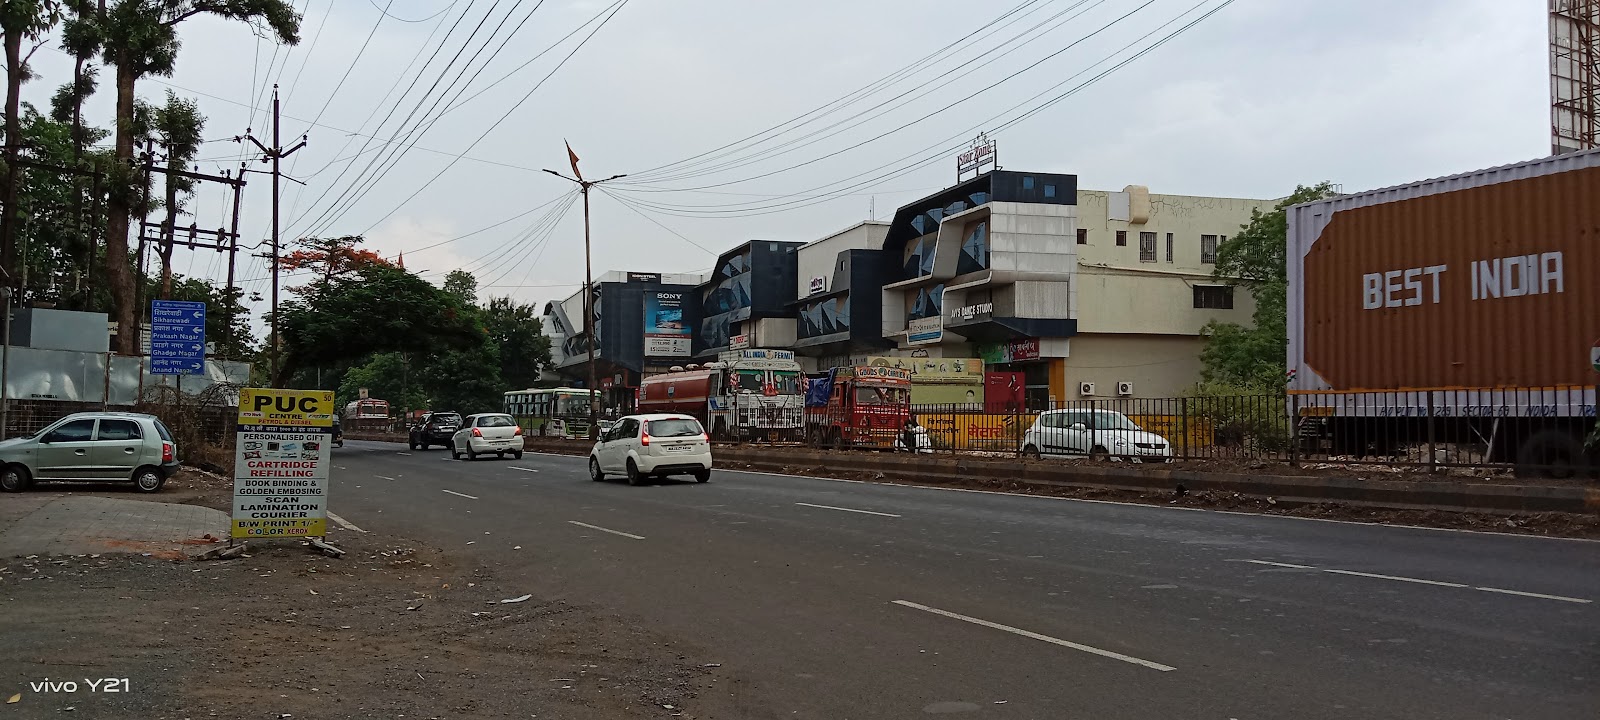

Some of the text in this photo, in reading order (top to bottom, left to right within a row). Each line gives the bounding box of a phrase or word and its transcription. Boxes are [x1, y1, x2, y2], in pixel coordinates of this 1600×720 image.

[1363, 251, 1564, 310] BEST INDIA
[962, 305, 976, 317] DANCE
[976, 302, 993, 314] STUDIO
[743, 350, 794, 360] ALL INDIA PERMIT
[860, 368, 878, 376] GOODS
[254, 396, 318, 412] PUC
[248, 528, 284, 536] COLOR
